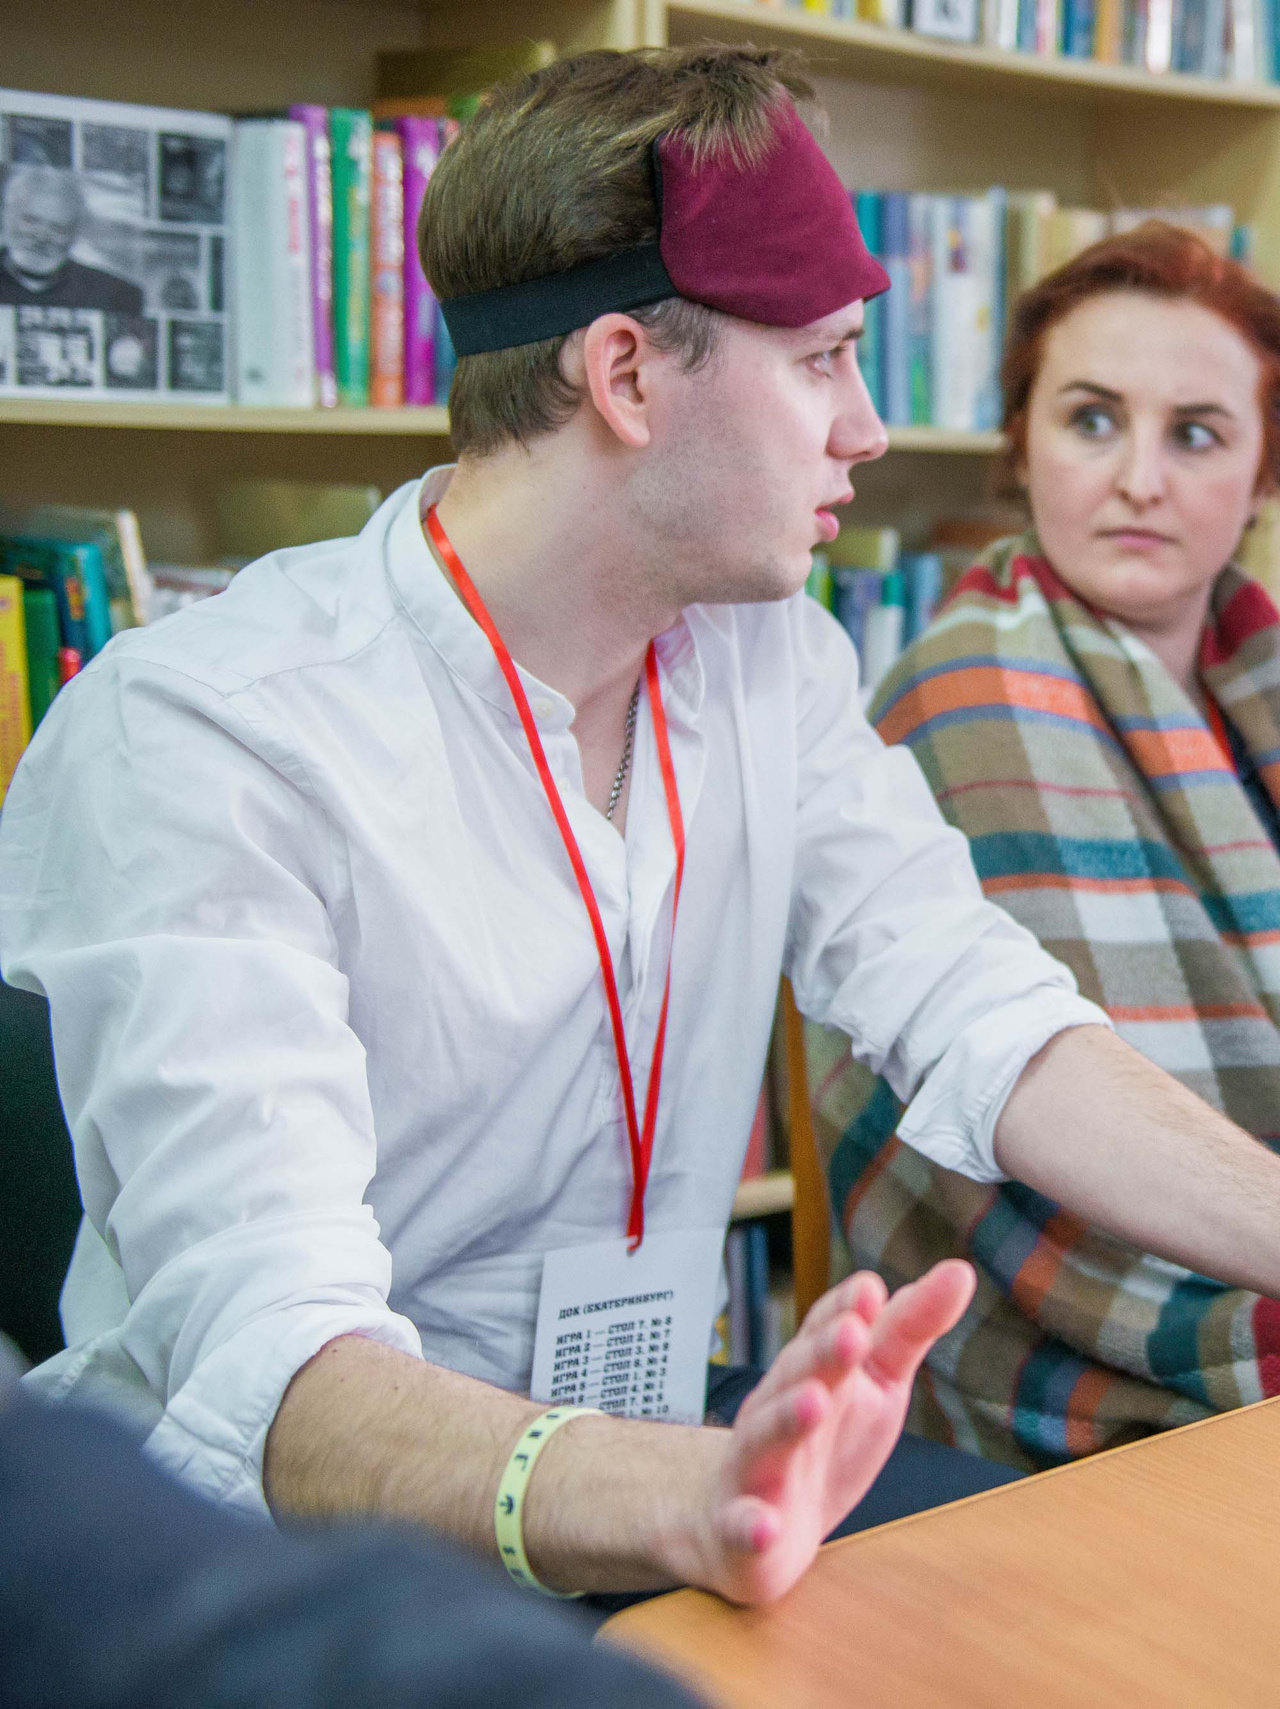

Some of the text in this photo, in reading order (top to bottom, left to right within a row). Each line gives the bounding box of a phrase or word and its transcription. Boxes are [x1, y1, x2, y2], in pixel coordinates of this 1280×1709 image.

[557, 1289, 674, 1321] ДОК (ЕКАТЕРИНБУРГ)
[556, 1331, 582, 1345] ИГРА
[555, 1344, 580, 1359] ИГРА
[584, 1341, 590, 1352] 2
[553, 1357, 579, 1372] ИГРА
[582, 1355, 588, 1365] 3
[552, 1370, 577, 1385] ИГРА
[550, 1383, 576, 1398] ИГРА
[657, 1404, 669, 1414] 10
